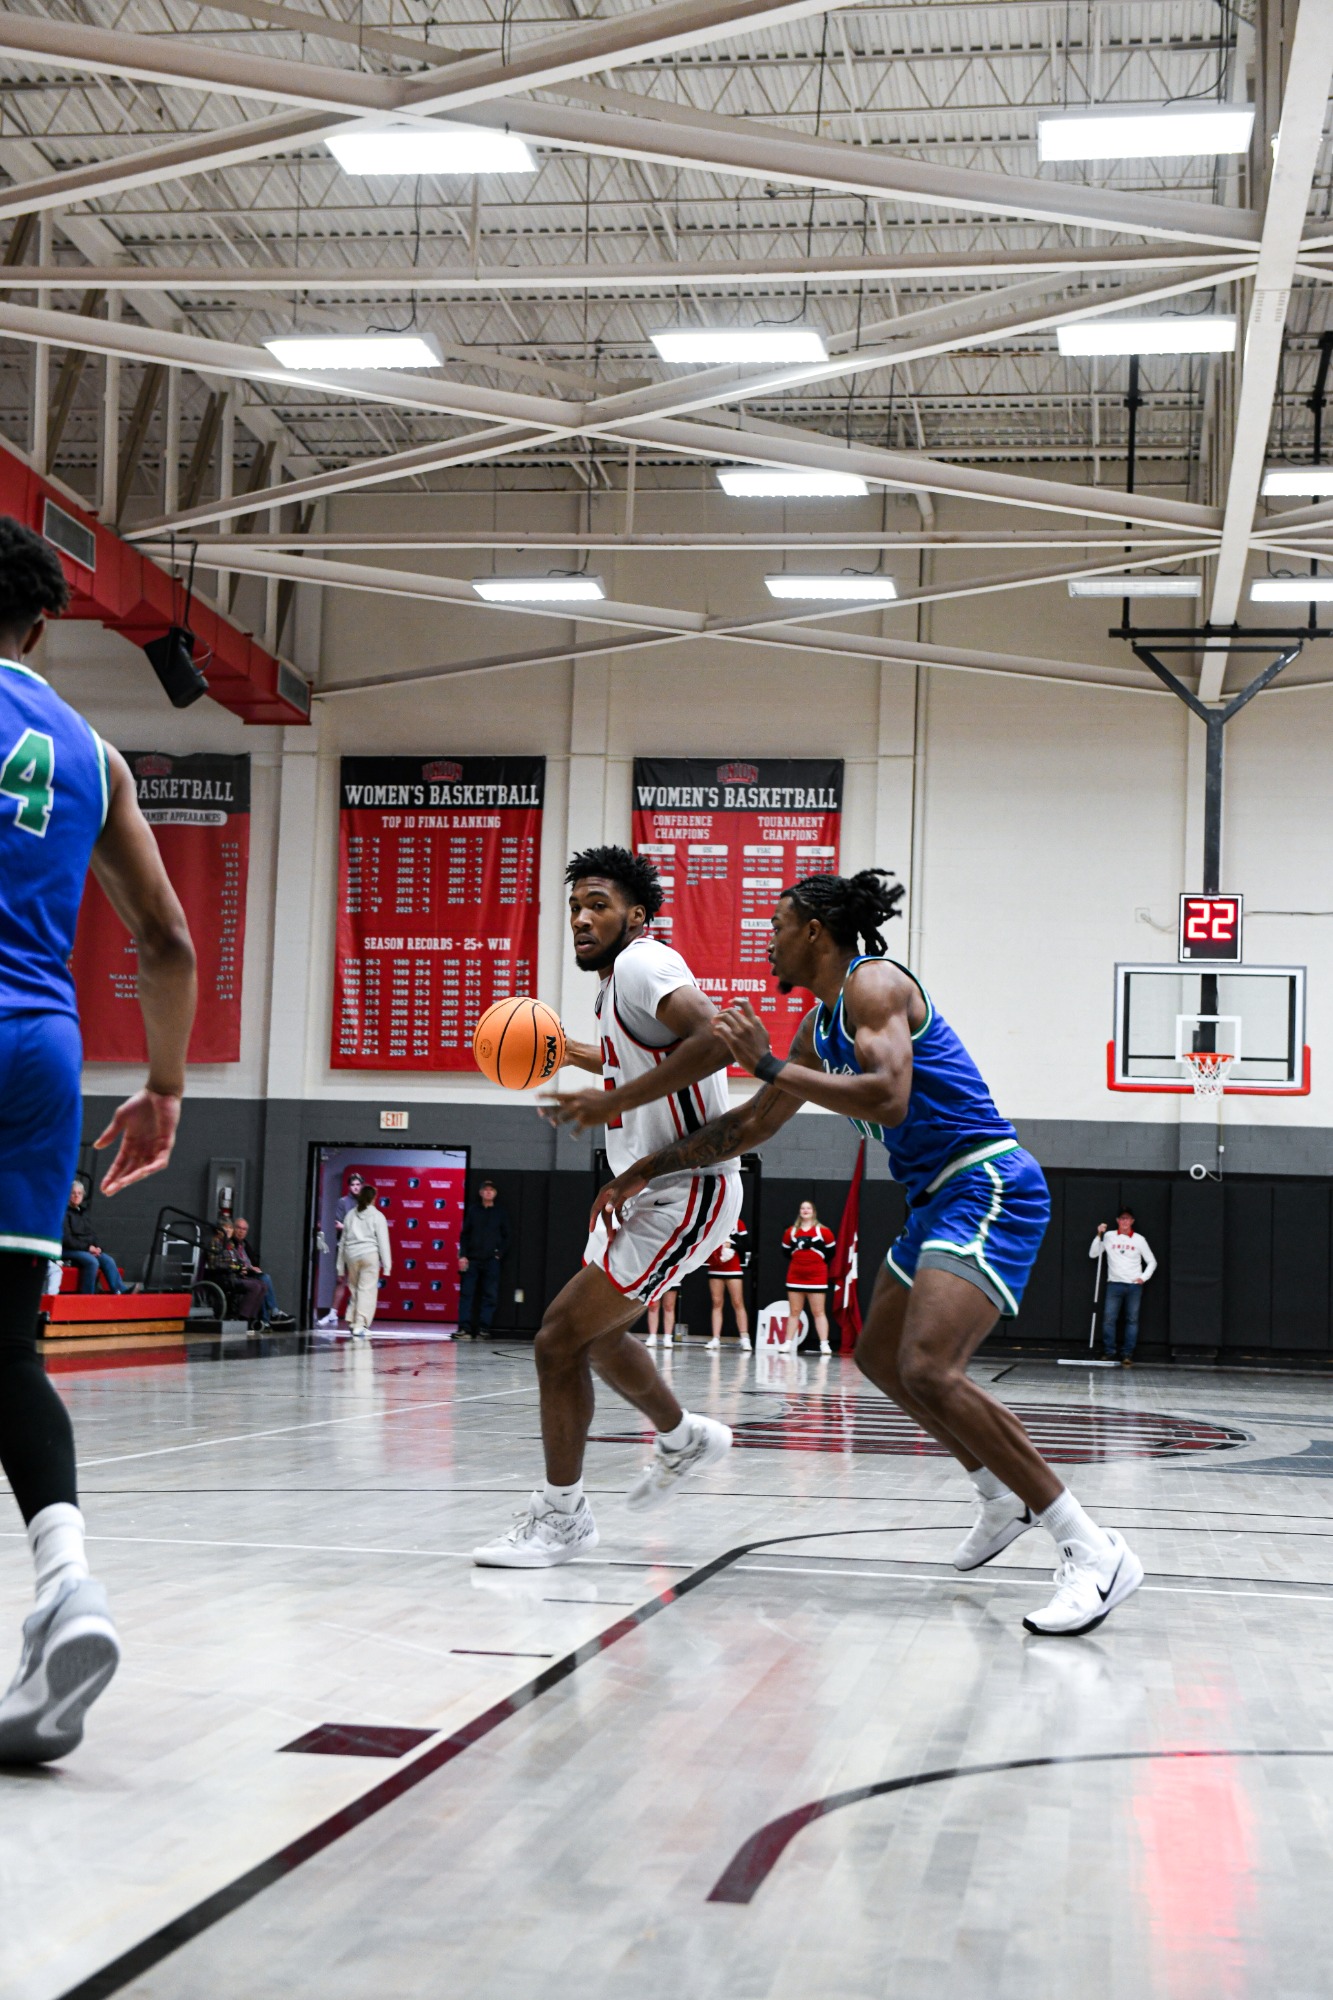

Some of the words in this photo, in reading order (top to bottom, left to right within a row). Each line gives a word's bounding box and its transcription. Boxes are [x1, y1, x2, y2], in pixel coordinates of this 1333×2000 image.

[0, 727, 55, 838] 4
[345, 785, 424, 805] WOMEN'S
[429, 785, 539, 805] BASKETBALL
[637, 786, 719, 808] WOMEN'S
[724, 787, 837, 808] BASKETBALL
[170, 811, 221, 822] APPEARANCES
[382, 816, 400, 828] TOP
[404, 816, 414, 828] 10
[418, 816, 449, 828] FINAL
[452, 816, 501, 828] RANKING
[653, 815, 713, 826] CONFERENCE
[758, 816, 825, 827] TOURNAMENT
[655, 828, 710, 840] CHAMPIONS
[763, 829, 818, 841] CHAMPIONS
[1187, 902, 1235, 939] 22
[364, 938, 404, 950] SEASON
[407, 938, 453, 950] RECORDS
[464, 938, 483, 950] 25+
[487, 938, 511, 950] WIN
[697, 979, 728, 991] FINAL
[731, 979, 766, 992] FOURS
[541, 1035, 557, 1077] NCAA
[385, 1112, 403, 1127] EXIT
